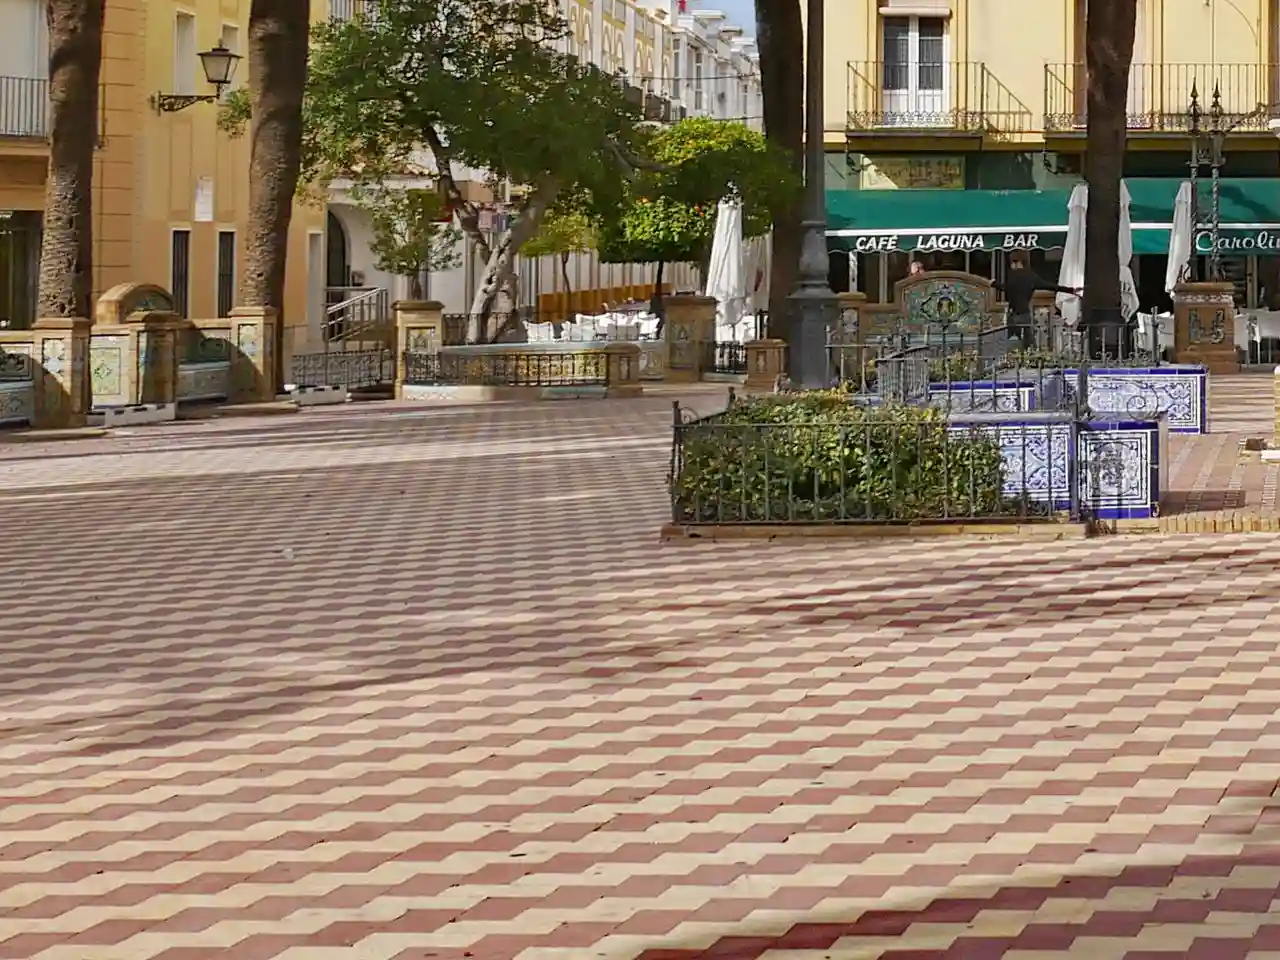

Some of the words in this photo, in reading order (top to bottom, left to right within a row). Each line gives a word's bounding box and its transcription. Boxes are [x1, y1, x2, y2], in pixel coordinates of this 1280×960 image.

[855, 234, 898, 250] CAFÉ
[917, 235, 985, 249] LAGUNA
[1003, 234, 1039, 248] BAR
